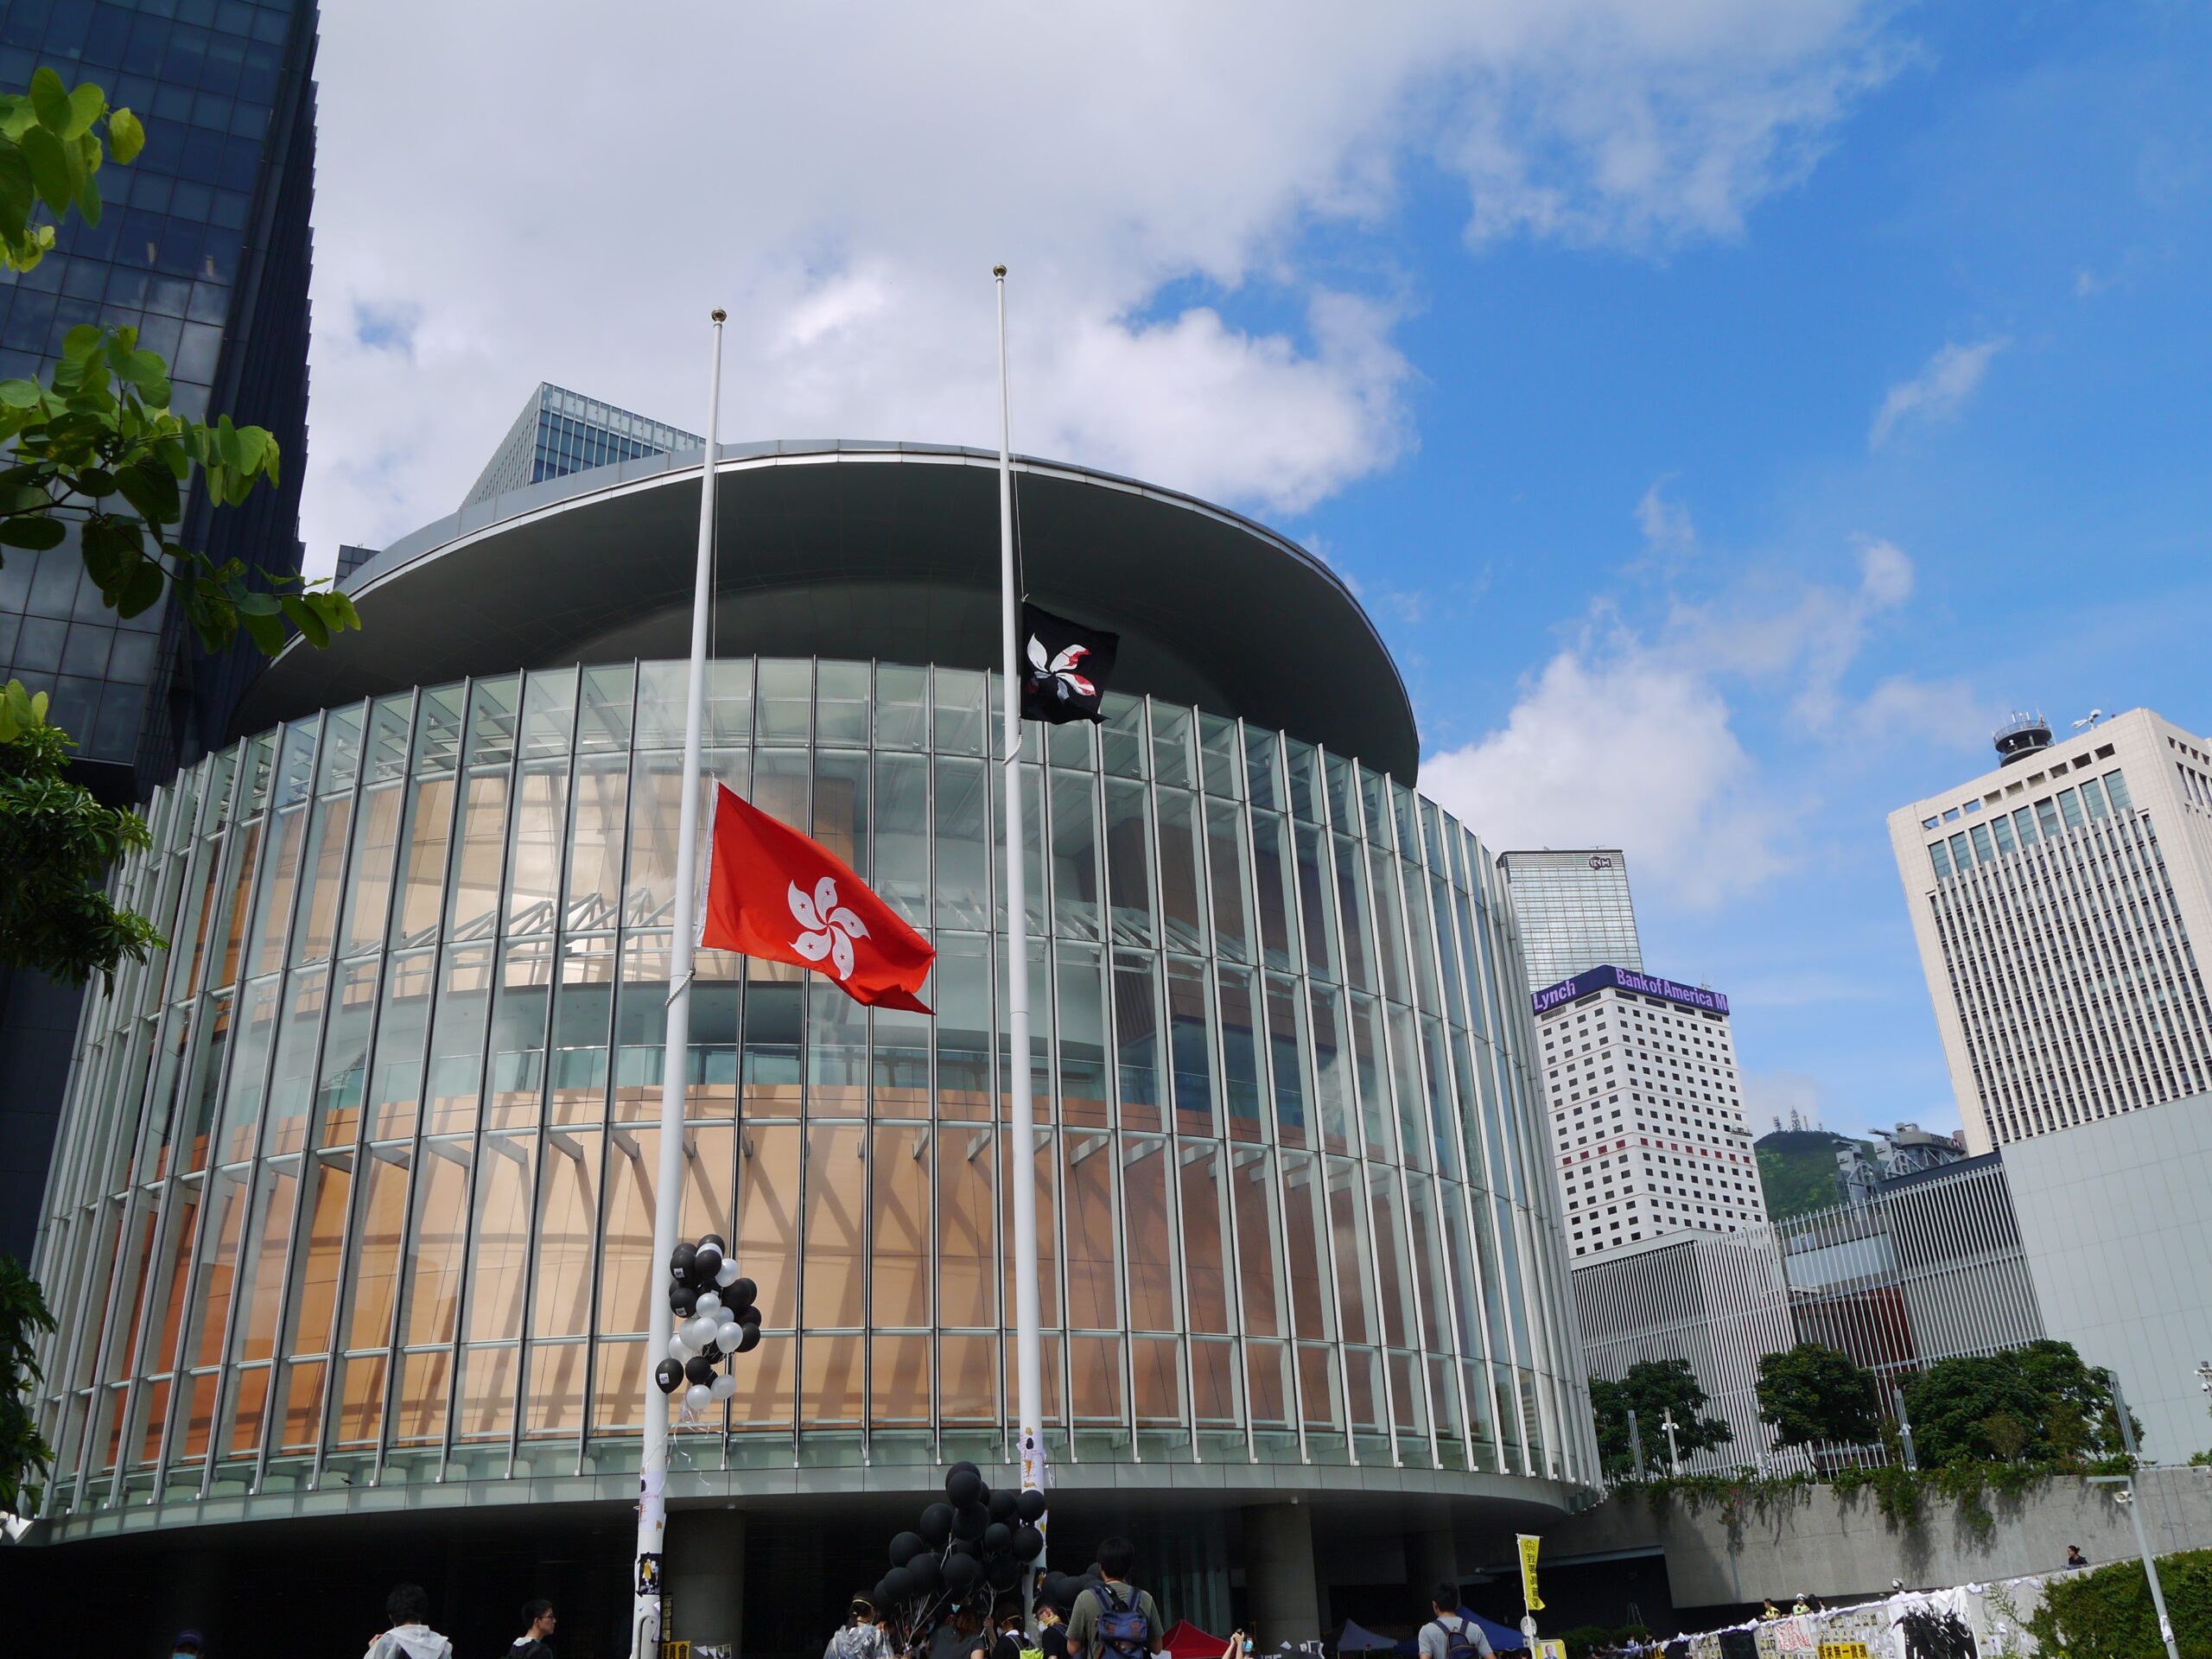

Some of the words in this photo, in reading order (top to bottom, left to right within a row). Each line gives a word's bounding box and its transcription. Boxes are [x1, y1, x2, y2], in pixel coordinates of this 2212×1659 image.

[1533, 980, 1576, 1010] Lynch
[1616, 968, 1649, 991] Bank
[1649, 978, 1662, 995] of
[1663, 981, 1713, 1008] America
[1714, 993, 1729, 1011] M
